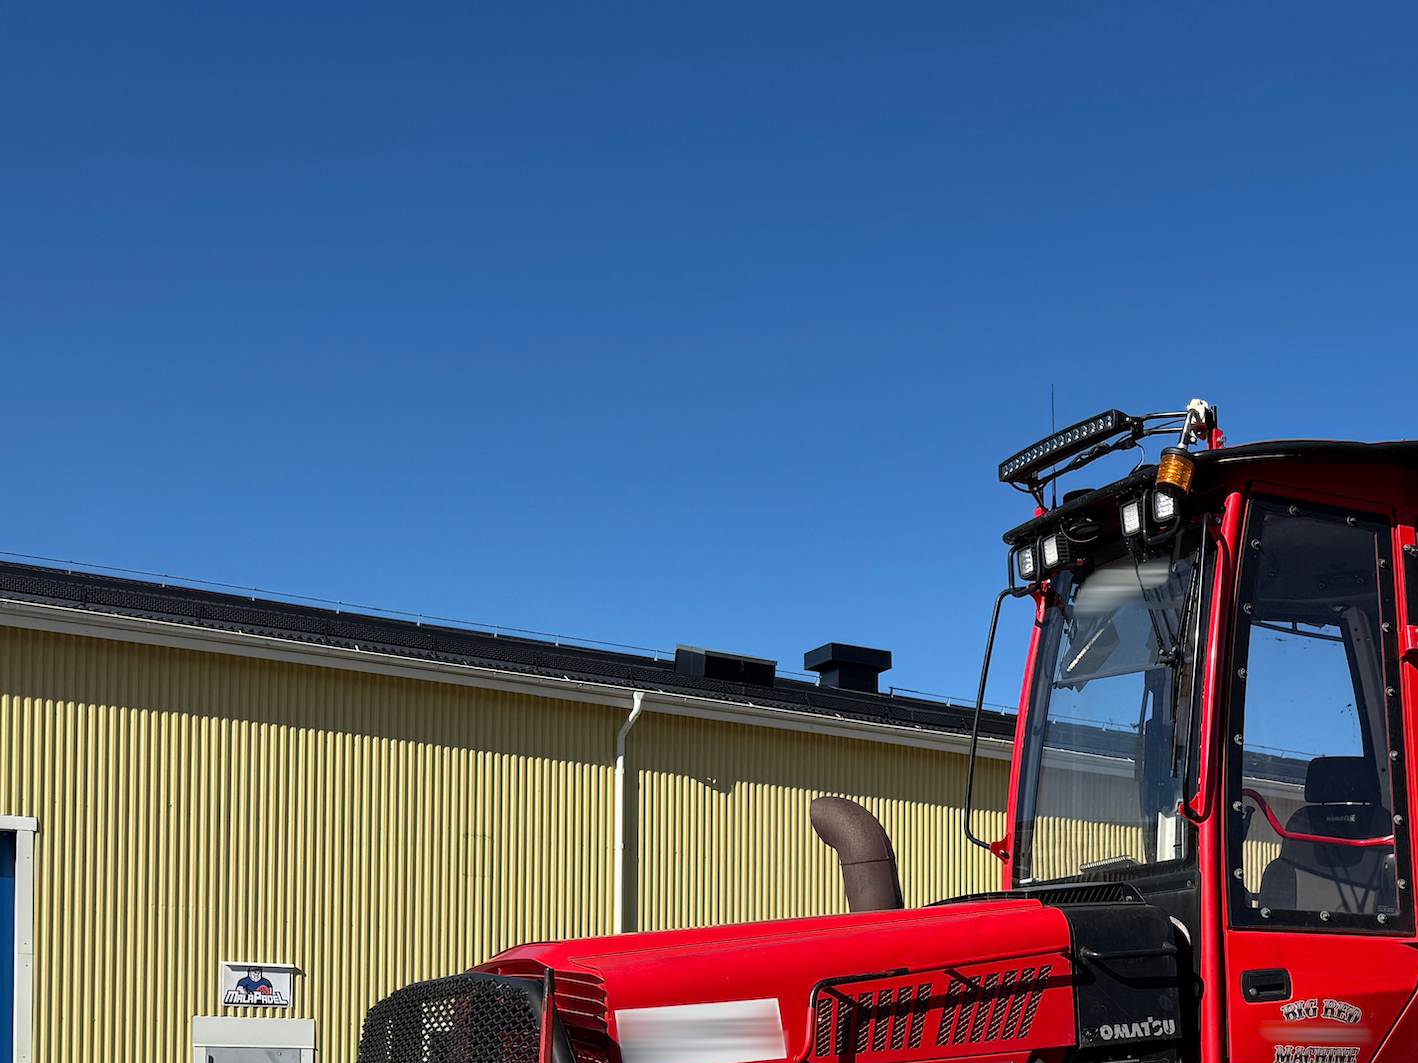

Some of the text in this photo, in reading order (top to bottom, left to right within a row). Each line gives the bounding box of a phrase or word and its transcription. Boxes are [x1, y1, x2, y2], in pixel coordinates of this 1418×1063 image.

[1280, 999, 1362, 1024] BIG RED
[1086, 1016, 1176, 1041] OMATSU
